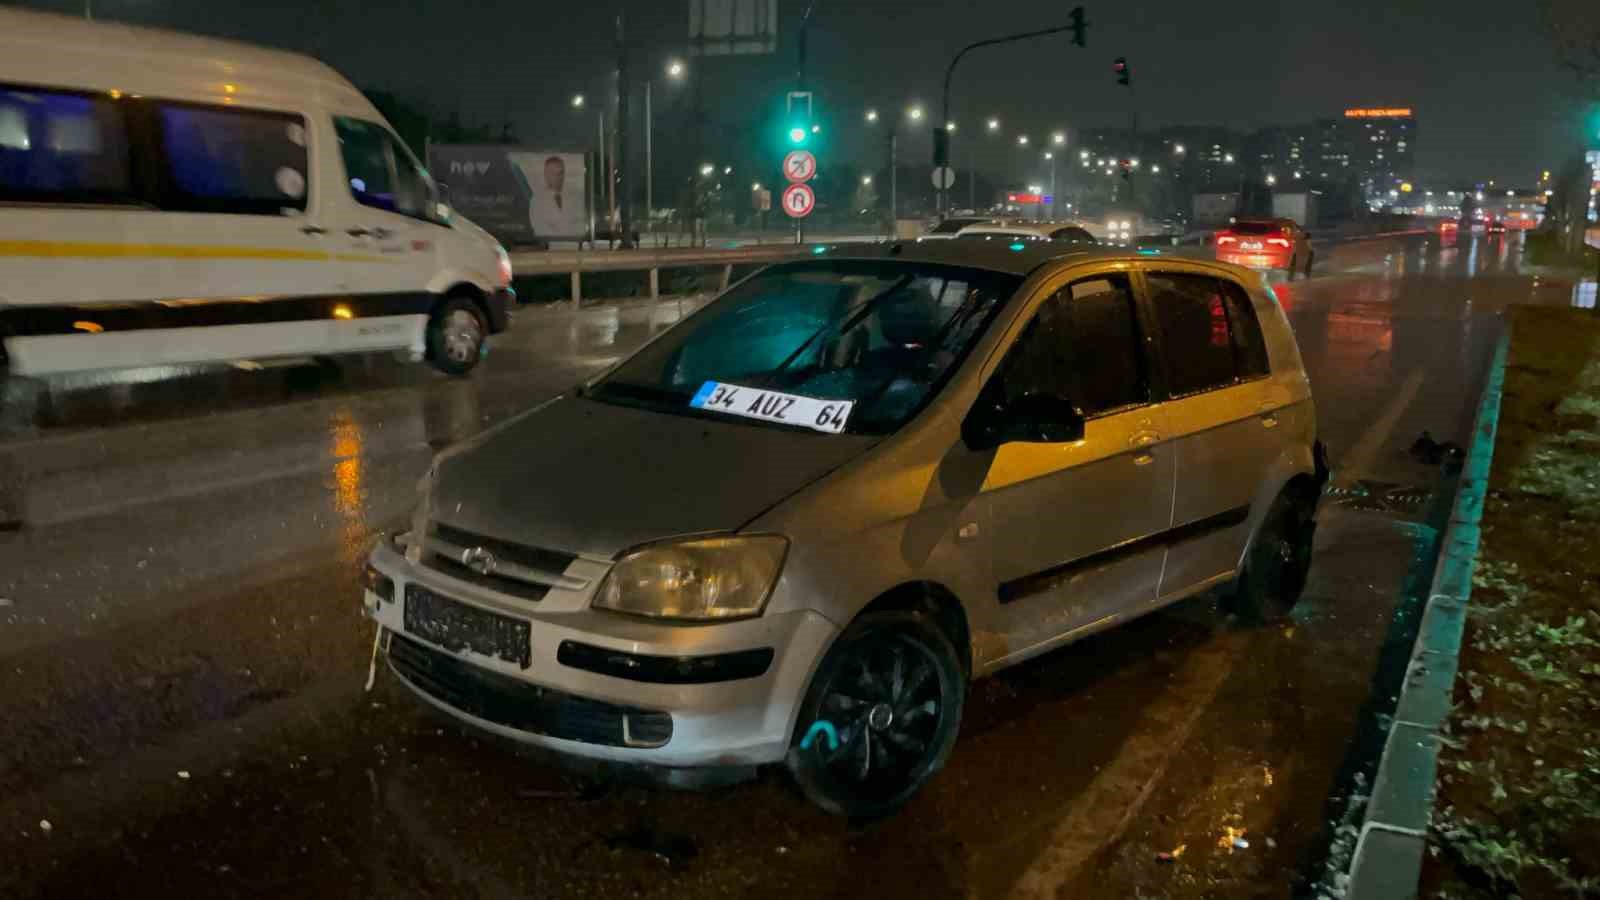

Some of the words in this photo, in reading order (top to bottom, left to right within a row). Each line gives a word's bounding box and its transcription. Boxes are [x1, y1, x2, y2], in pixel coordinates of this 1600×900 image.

[708, 386, 740, 408] 34
[747, 392, 795, 419] AUZ
[815, 404, 848, 430] 64
